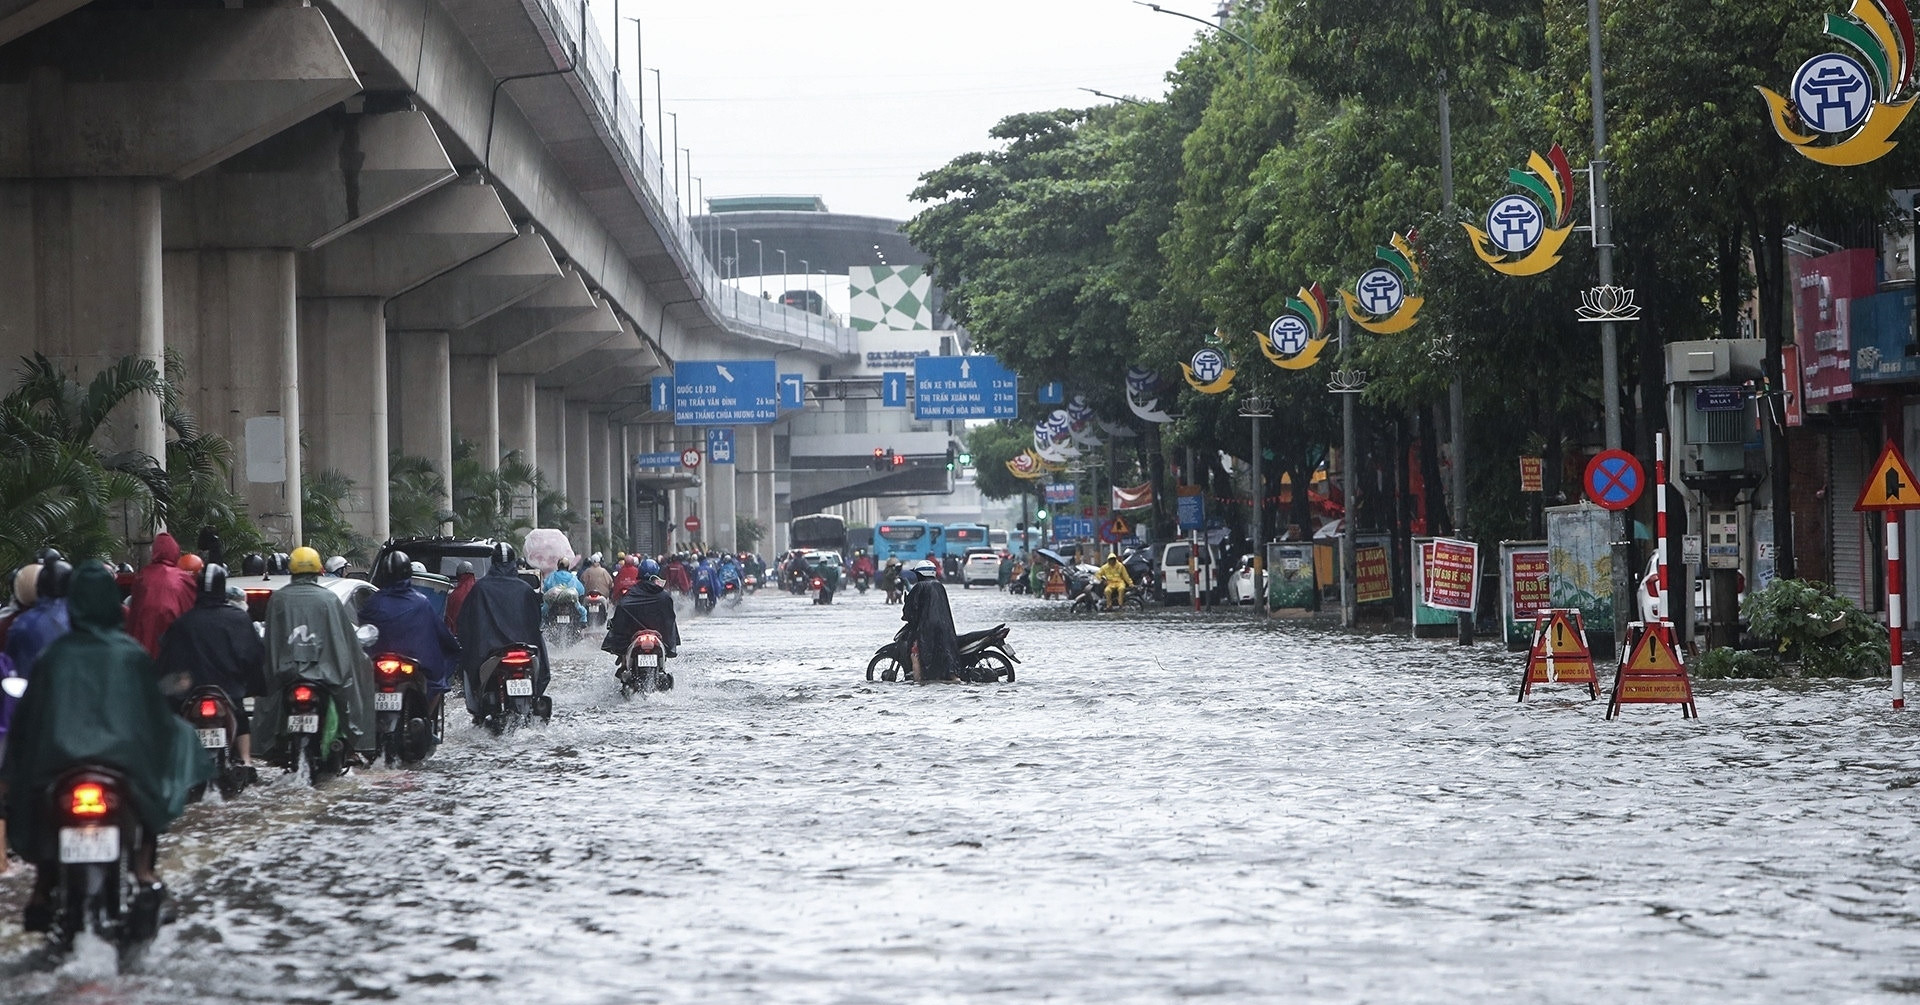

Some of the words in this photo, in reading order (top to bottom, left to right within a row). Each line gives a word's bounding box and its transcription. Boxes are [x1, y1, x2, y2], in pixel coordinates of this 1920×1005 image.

[676, 384, 693, 394] QUỐC
[694, 384, 703, 394] LỘ
[704, 385, 717, 394] 21B
[920, 379, 932, 389] BẾN
[934, 381, 942, 389] XE
[944, 380, 956, 389] YÊN
[677, 398, 686, 408] THỊ
[690, 396, 706, 406] TRẤN
[756, 398, 764, 406] 26
[766, 398, 775, 406] km
[920, 394, 931, 403] THỊ
[932, 392, 948, 402] TRẤN
[950, 392, 967, 402] XUÂN
[969, 394, 980, 402] MAI
[994, 394, 1002, 402] 21
[920, 404, 940, 414] THÀNH
[942, 404, 954, 414] PHỐ
[956, 404, 968, 414] HÒA
[970, 404, 986, 414] BÌNH
[1004, 406, 1014, 414] km
[676, 412, 694, 420] DANH
[766, 410, 776, 418] km
[1516, 578, 1525, 592] TỪ
[1526, 580, 1538, 592] 636
